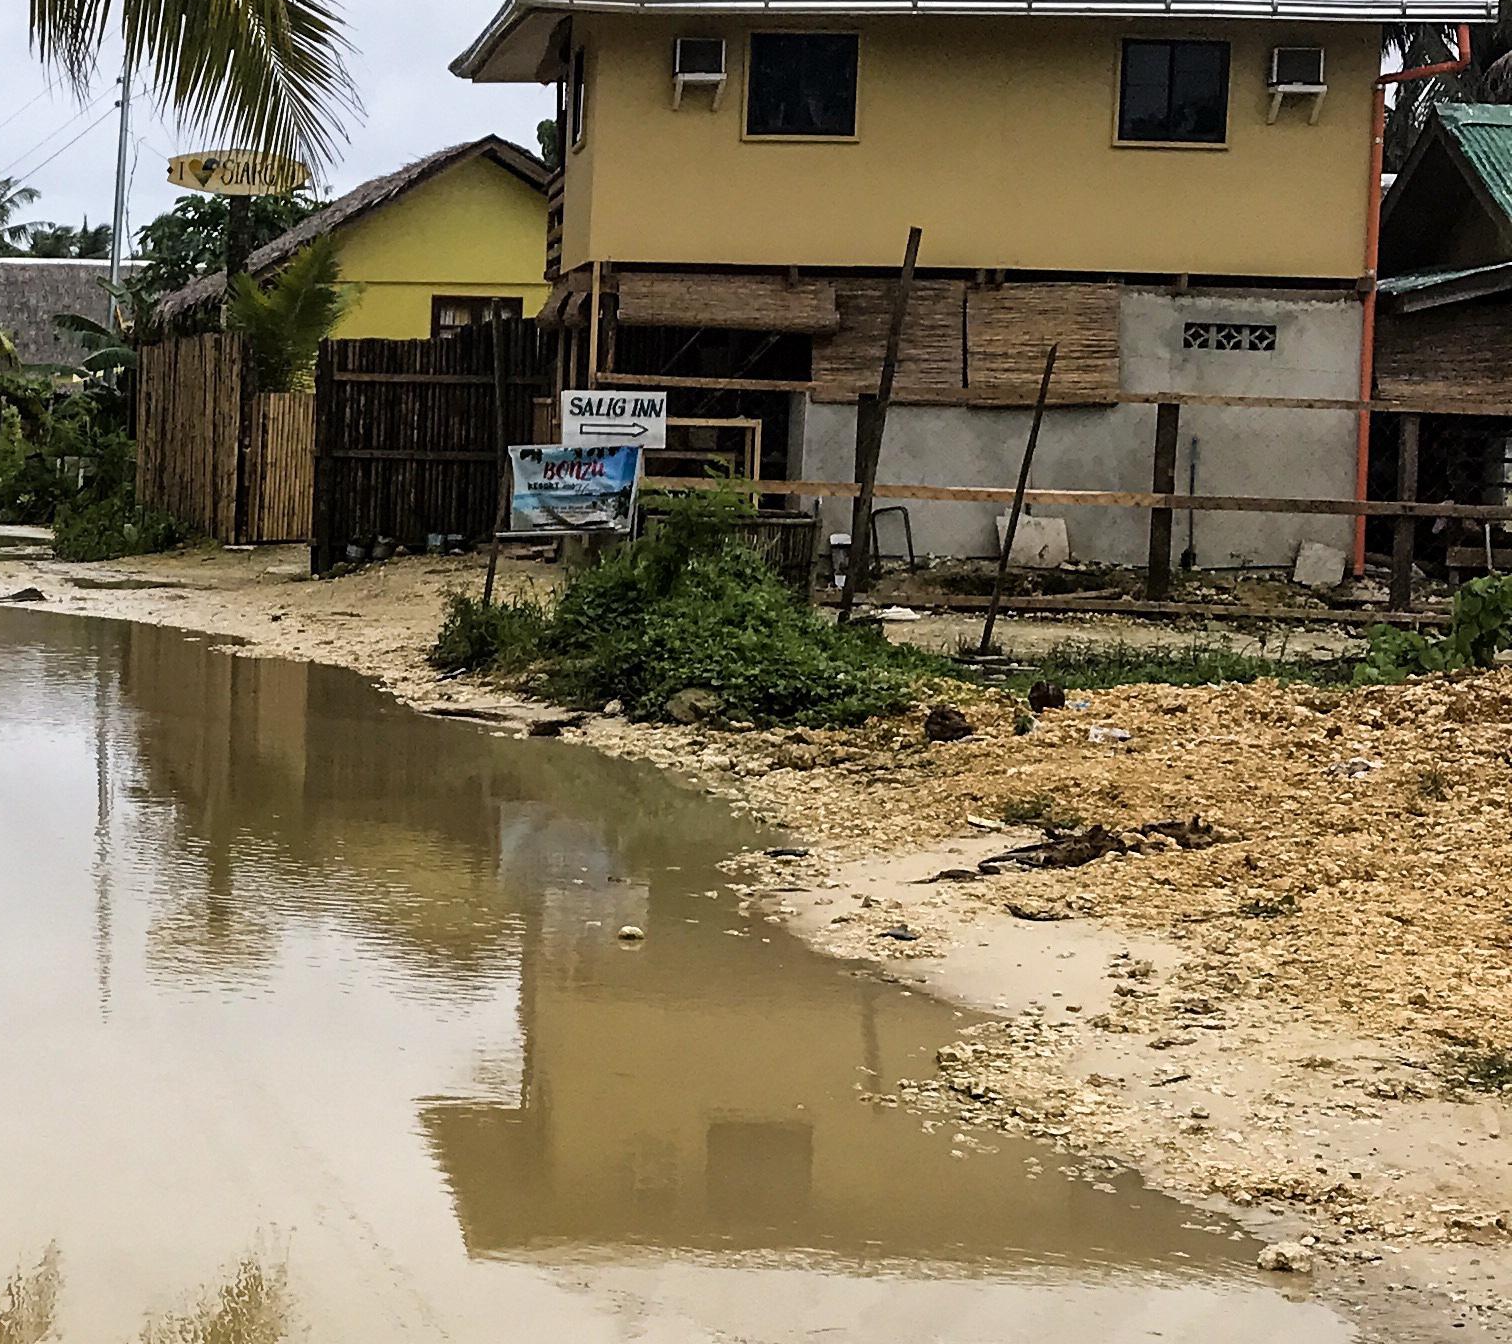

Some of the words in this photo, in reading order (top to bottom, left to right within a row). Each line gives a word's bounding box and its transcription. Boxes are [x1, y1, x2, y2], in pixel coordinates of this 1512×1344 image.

[178, 161, 184, 180] I
[569, 396, 627, 417] SALIG
[630, 398, 665, 418] INN
